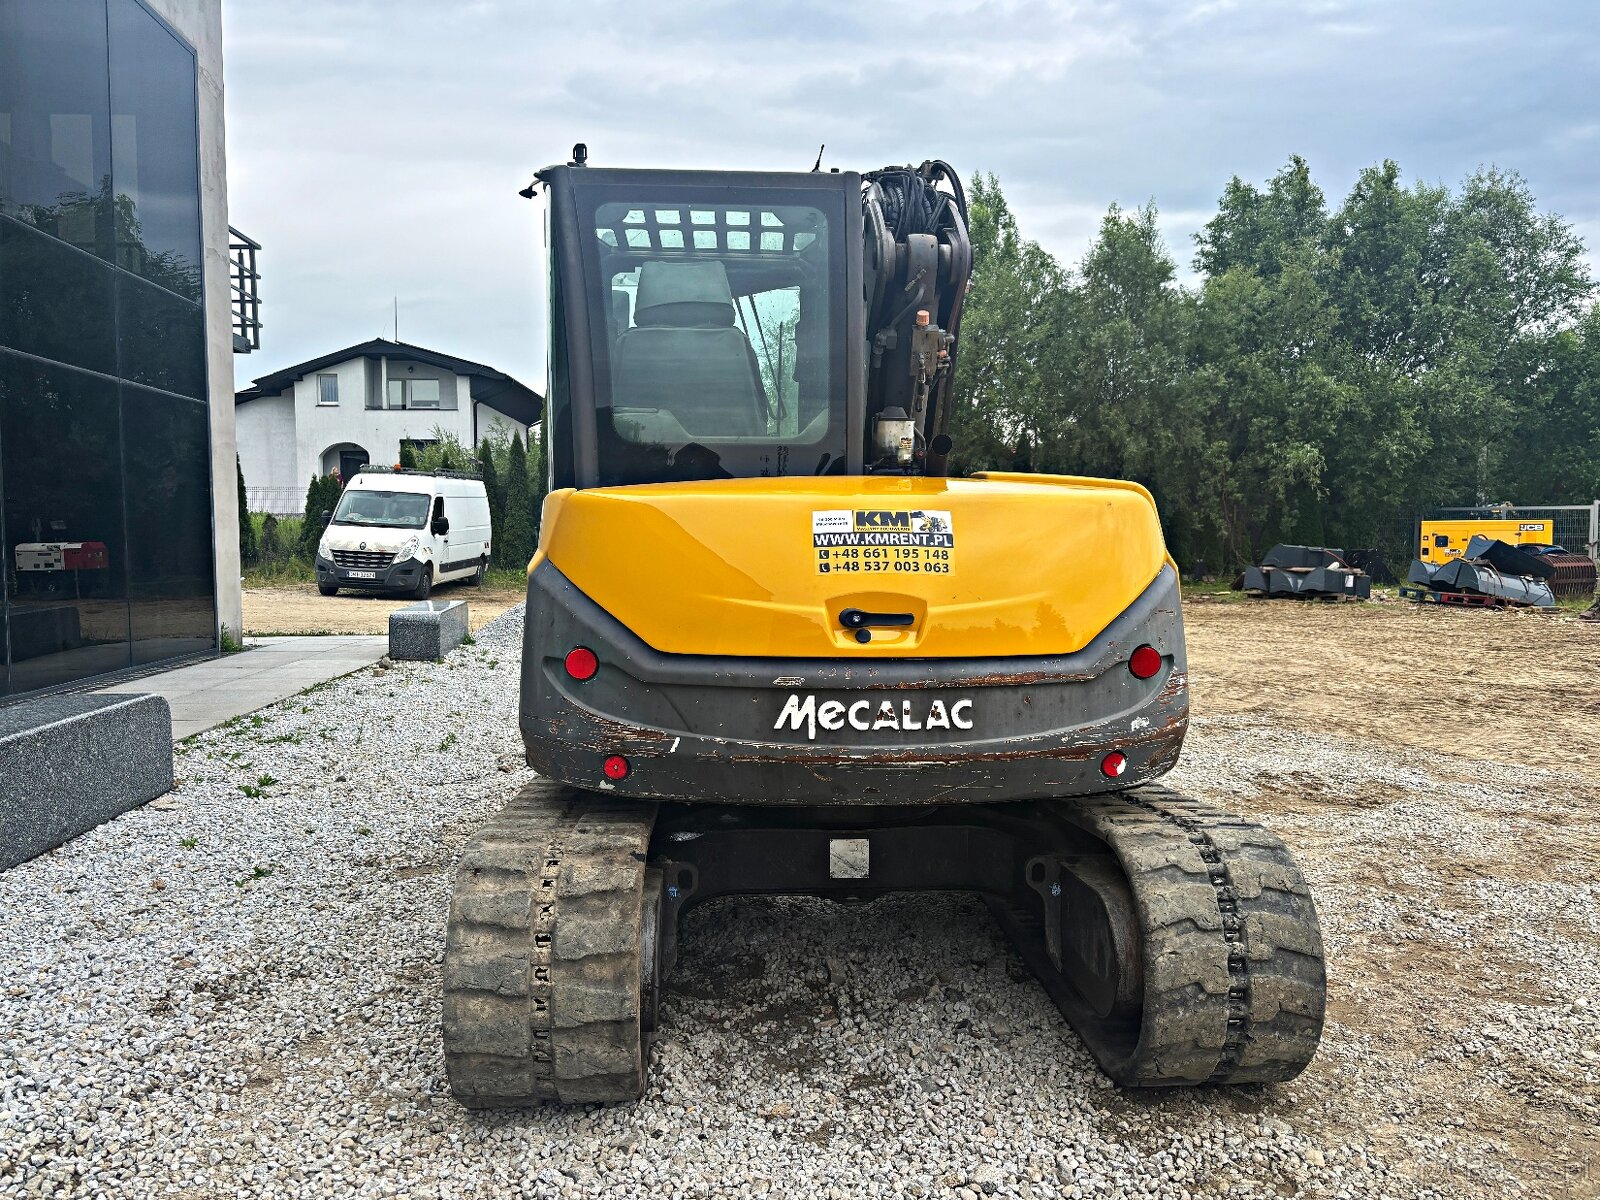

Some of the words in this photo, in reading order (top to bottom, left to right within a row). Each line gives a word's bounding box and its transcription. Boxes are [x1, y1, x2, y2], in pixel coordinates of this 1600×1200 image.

[855, 511, 910, 527] KM
[814, 533, 952, 547] WWW.KMRENT.PL
[832, 549, 859, 559] +48
[863, 548, 888, 559] 661
[894, 548, 919, 559] 195
[924, 550, 949, 560] 148
[832, 561, 860, 572] +48
[864, 561, 890, 572] 537
[894, 561, 920, 572] 003
[924, 562, 949, 573] 063
